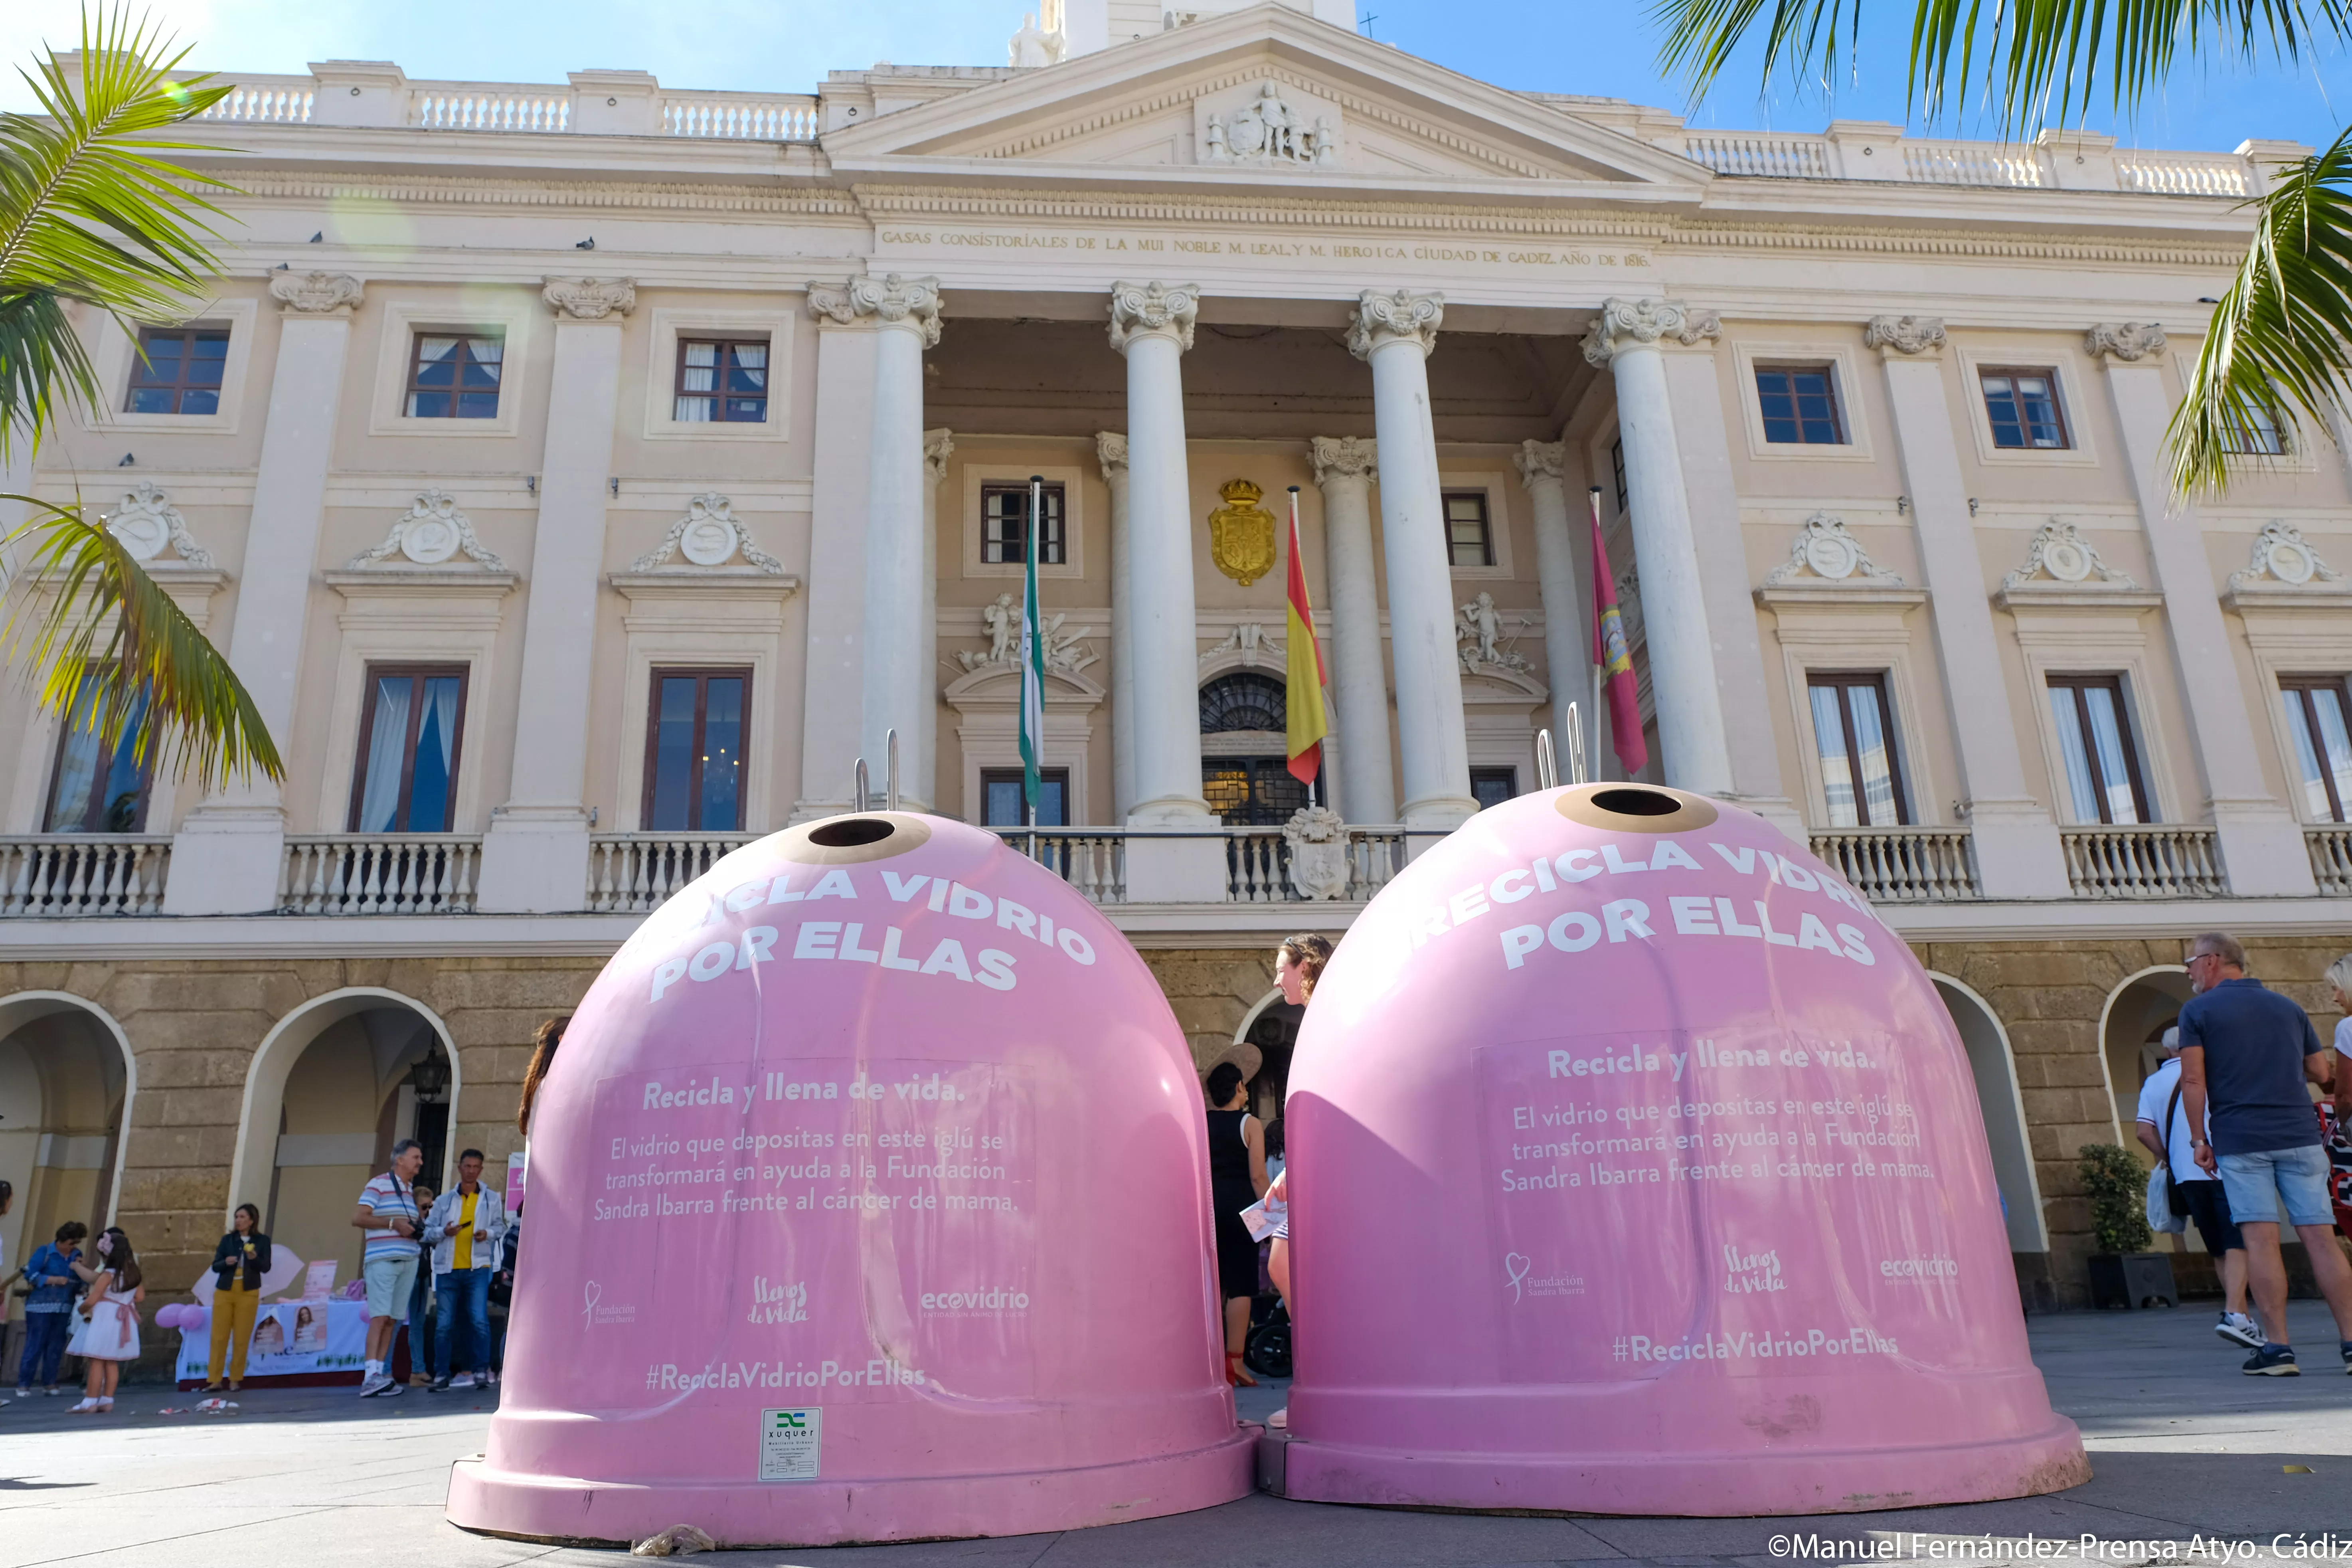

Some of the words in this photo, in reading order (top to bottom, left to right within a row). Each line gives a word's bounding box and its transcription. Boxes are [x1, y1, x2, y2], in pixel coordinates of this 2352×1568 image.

[882, 231, 932, 243] CASAS
[940, 232, 1068, 248] CONSISTORIALES
[1076, 237, 1096, 249] DE
[1106, 238, 1128, 250] LA
[1138, 239, 1164, 251] MUI
[1174, 240, 1221, 253] NOBLE
[1229, 242, 1245, 254] M.
[1291, 244, 1304, 256] Y
[1309, 245, 1326, 257] M.
[1333, 245, 1407, 259] HEROICA
[1414, 246, 1477, 261] CIUDAD
[1482, 250, 1502, 262] DE
[1507, 252, 1557, 264] CADIZ.
[1560, 250, 1591, 265] AÑO
[1598, 254, 1617, 266] DE
[880, 871, 1096, 966] VIDRIO
[1499, 898, 1657, 970] POR
[1668, 896, 1876, 966] ELLAS
[650, 925, 779, 1004] POR
[793, 922, 1017, 991] ELLAS
[1548, 1044, 1660, 1079] Recicla
[1670, 1051, 1688, 1082] y
[1696, 1039, 1771, 1068] llena
[1779, 1040, 1809, 1068] de
[1815, 1040, 1876, 1069] vida.
[643, 1076, 734, 1110] Recicla
[743, 1084, 757, 1114] y
[765, 1072, 839, 1101] llena
[848, 1072, 885, 1100] de
[893, 1073, 965, 1102] vida.
[1513, 1106, 1535, 1130] El
[1542, 1102, 1608, 1127] vidrio
[1615, 1103, 1660, 1129] que
[1667, 1094, 1777, 1125] depositas
[1783, 1100, 1806, 1116] en
[1812, 1098, 1855, 1116] este
[1861, 1094, 1891, 1125] iglú
[1896, 1102, 1912, 1118] se
[611, 1137, 625, 1160] El
[630, 1133, 680, 1158] vidrio
[686, 1138, 725, 1162] que
[732, 1126, 835, 1158] depositas
[842, 1132, 869, 1148] en
[878, 1129, 926, 1148] este
[934, 1125, 973, 1157] iglú
[980, 1134, 1003, 1150] se
[1512, 1129, 1666, 1161] transformará
[1675, 1133, 1704, 1150] en
[1712, 1123, 1780, 1155] ayuda
[1787, 1130, 1798, 1146] a
[1803, 1123, 1816, 1146] la
[1825, 1122, 1921, 1149] Fundación
[606, 1161, 725, 1190] transformará
[733, 1165, 755, 1182] en
[763, 1156, 831, 1188] ayuda
[839, 1163, 851, 1178] a
[860, 1155, 877, 1178] la
[887, 1156, 1006, 1180] Fundación
[1501, 1166, 1581, 1192] Sandra
[1589, 1162, 1660, 1186] Ibarra
[1668, 1157, 1744, 1181] frente
[1751, 1155, 1769, 1179] al
[1776, 1155, 1844, 1179] cáncer
[1851, 1154, 1876, 1177] de
[1881, 1163, 1935, 1179] mama.
[594, 1196, 649, 1221] Sandra
[656, 1192, 714, 1217] Ibarra
[722, 1190, 789, 1213] frente
[795, 1186, 815, 1210] al
[822, 1187, 902, 1211] cáncer
[908, 1186, 937, 1211] de
[944, 1194, 1019, 1212] mama.
[1527, 1274, 1584, 1287] Fundación
[1724, 1273, 1742, 1293] de
[1741, 1267, 1788, 1294] vida
[1880, 1253, 1959, 1277] ecovidrio
[596, 1303, 635, 1315] Fundación
[921, 1285, 1029, 1309] ecovidrio
[1528, 1287, 1557, 1297] Sandra
[747, 1304, 764, 1324] de
[765, 1298, 812, 1325] vida
[1612, 1327, 1899, 1362] #ReciclaVidrioPorEllas
[646, 1360, 926, 1391] #ReciclaVidrioPorEllas
[769, 1430, 814, 1440] xuquer
